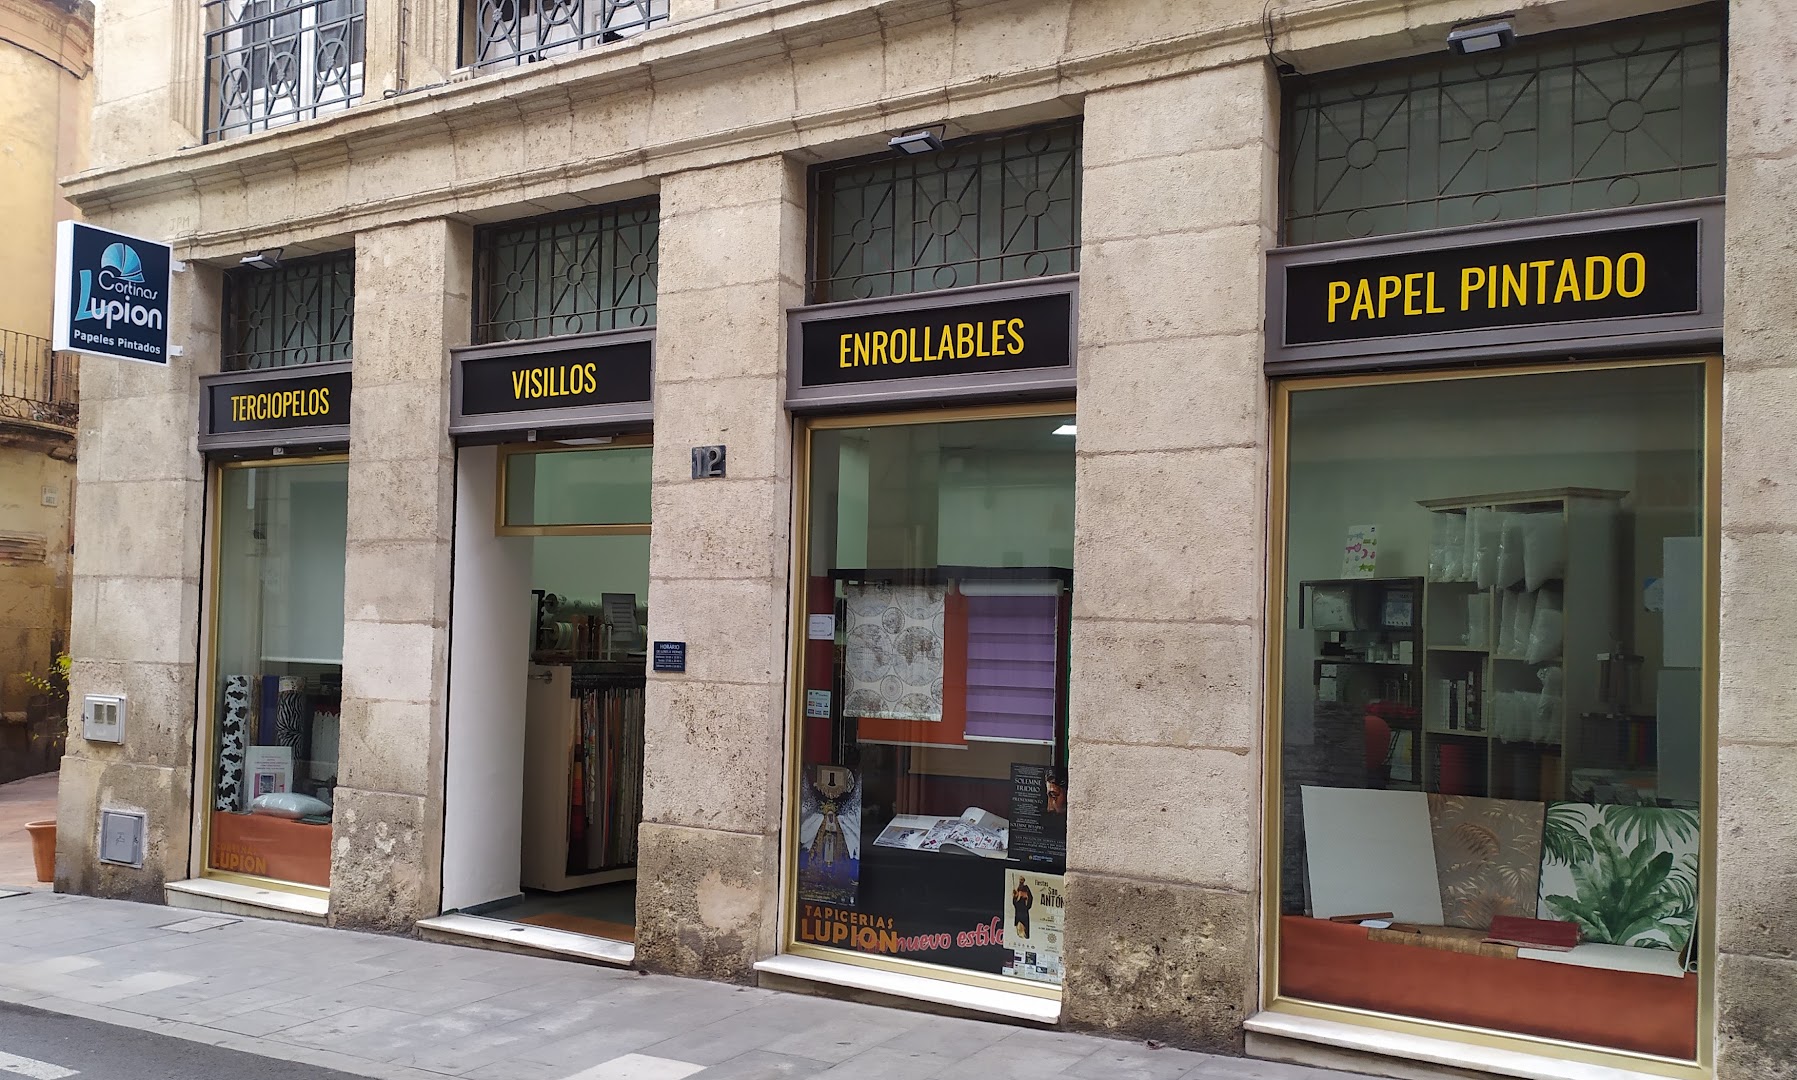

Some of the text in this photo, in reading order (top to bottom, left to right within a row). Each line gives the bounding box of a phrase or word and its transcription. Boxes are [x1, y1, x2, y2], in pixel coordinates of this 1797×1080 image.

[74, 269, 162, 330] Lupion
[98, 270, 158, 300] Cortinas
[1327, 252, 1646, 323] PAPEL PINTADO
[74, 329, 161, 354] Papeles Pintados
[839, 317, 1025, 369] ENROLLABLES
[511, 362, 597, 398] VISILLOS
[231, 388, 330, 421] TERCIOPELOS
[694, 447, 722, 476] 12
[1048, 886, 1058, 895] San
[805, 905, 894, 929] TAPICERIAS
[801, 918, 898, 953] LUPION
[894, 932, 951, 952] nuevo
